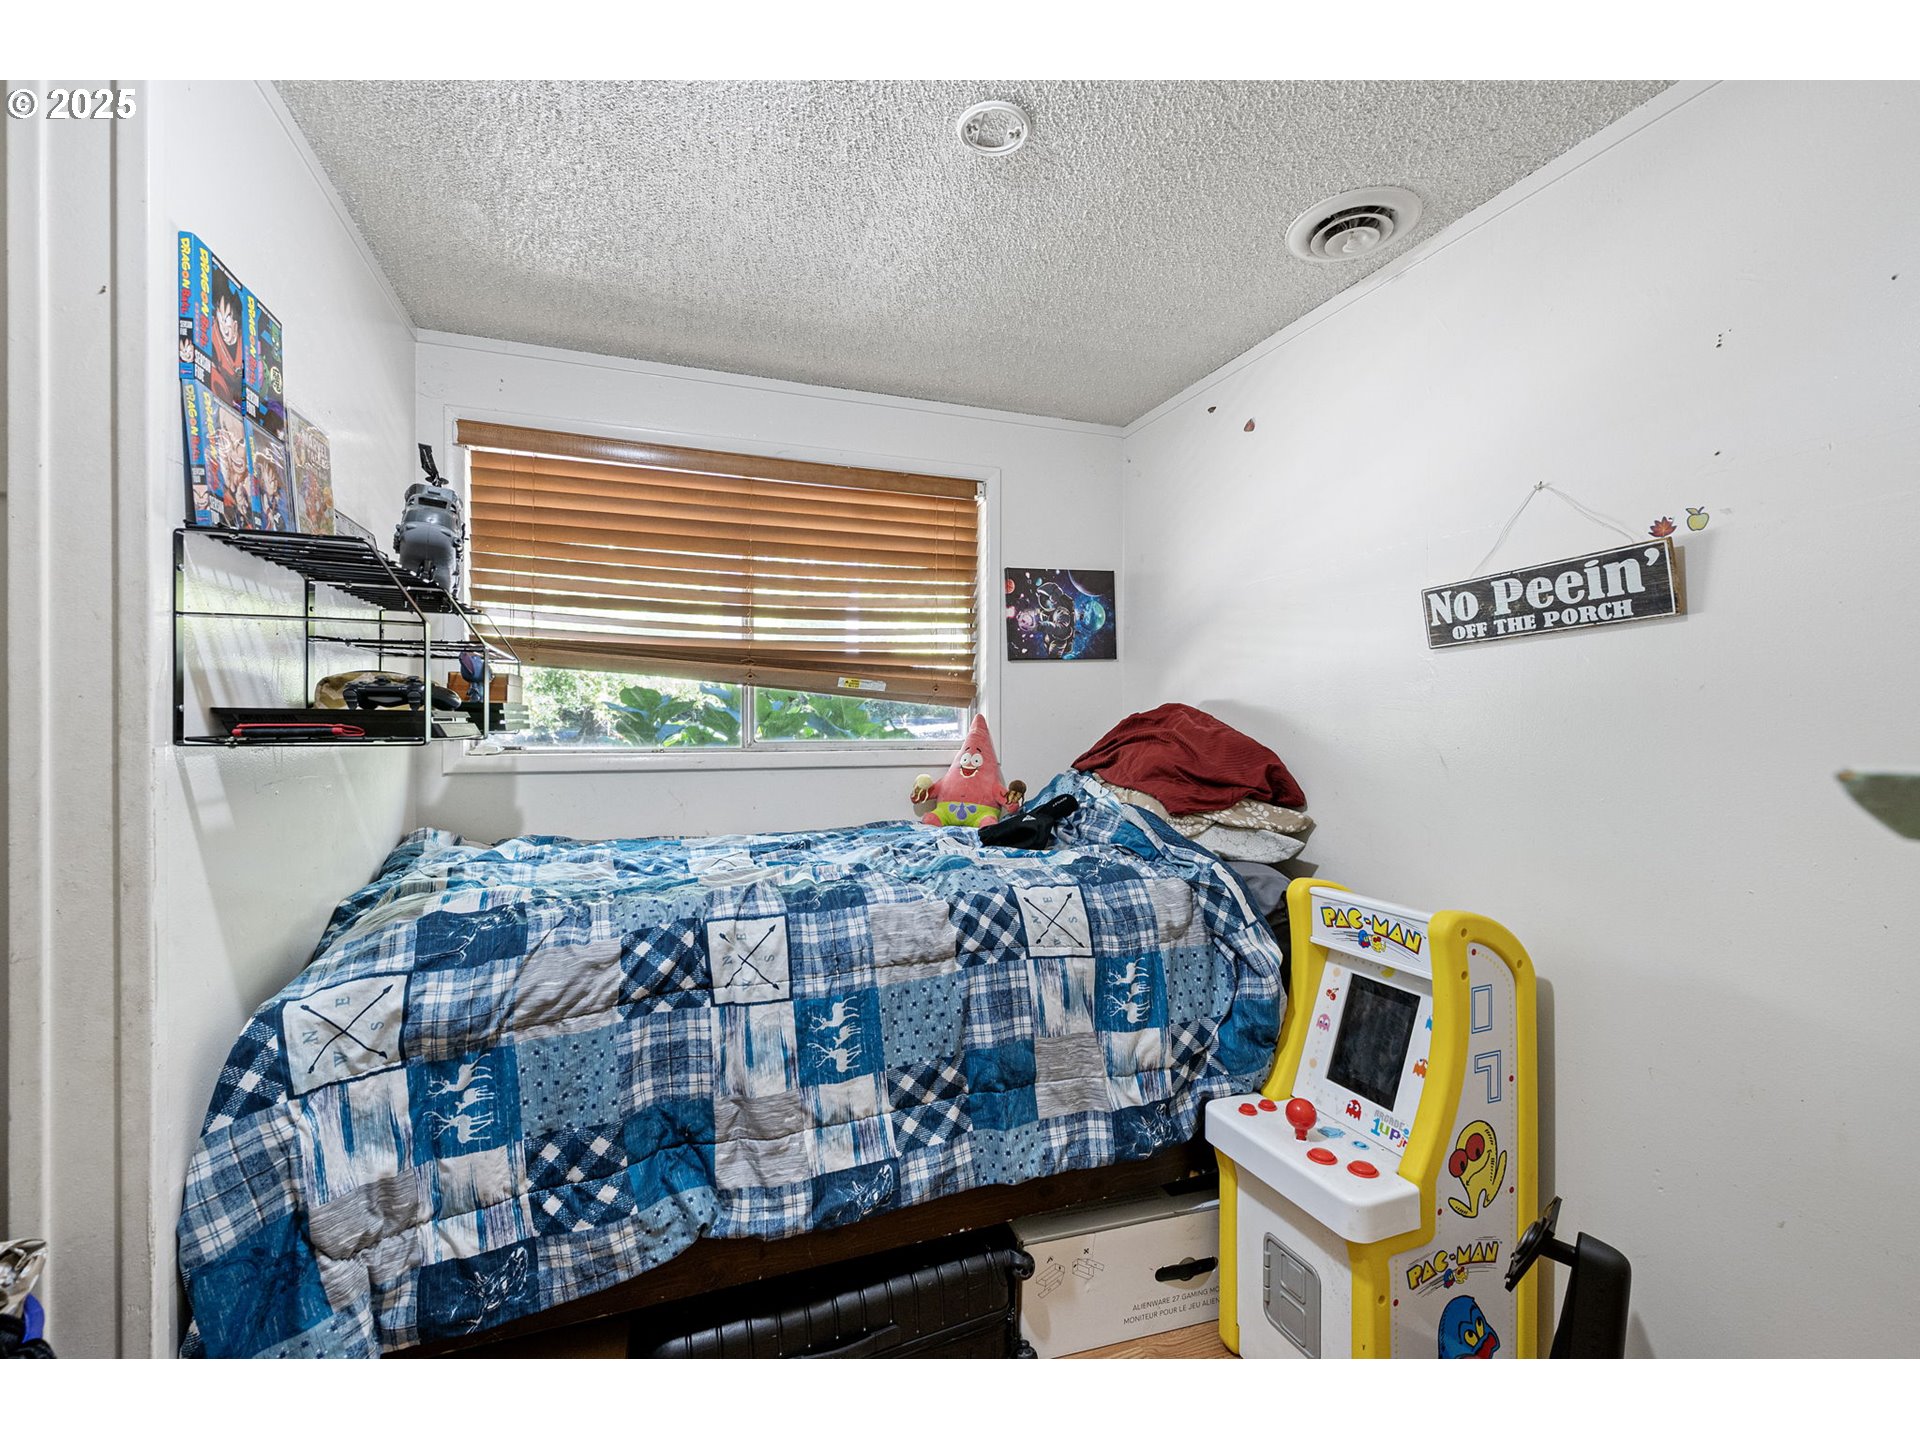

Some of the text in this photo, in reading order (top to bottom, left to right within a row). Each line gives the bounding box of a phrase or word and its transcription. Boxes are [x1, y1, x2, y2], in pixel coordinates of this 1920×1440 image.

[180, 237, 191, 288] DRAGON
[199, 247, 210, 317] DRAGON
[185, 384, 198, 435] DRAGON
[1427, 547, 1660, 626] No Peein'
[1452, 599, 1634, 640] OFF THE PORCH
[1320, 906, 1422, 955] PAC-MAN
[1406, 1241, 1499, 1290] PAC-MAN
[1123, 1311, 1158, 1325] MONITEUR
[1159, 1306, 1178, 1317] POUR
[1178, 1304, 1187, 1313] LE
[1188, 1301, 1201, 1310] JEU
[1132, 1296, 1170, 1312] ALIENWARE
[1171, 1294, 1180, 1303] 27
[1181, 1288, 1208, 1300] GAMING
